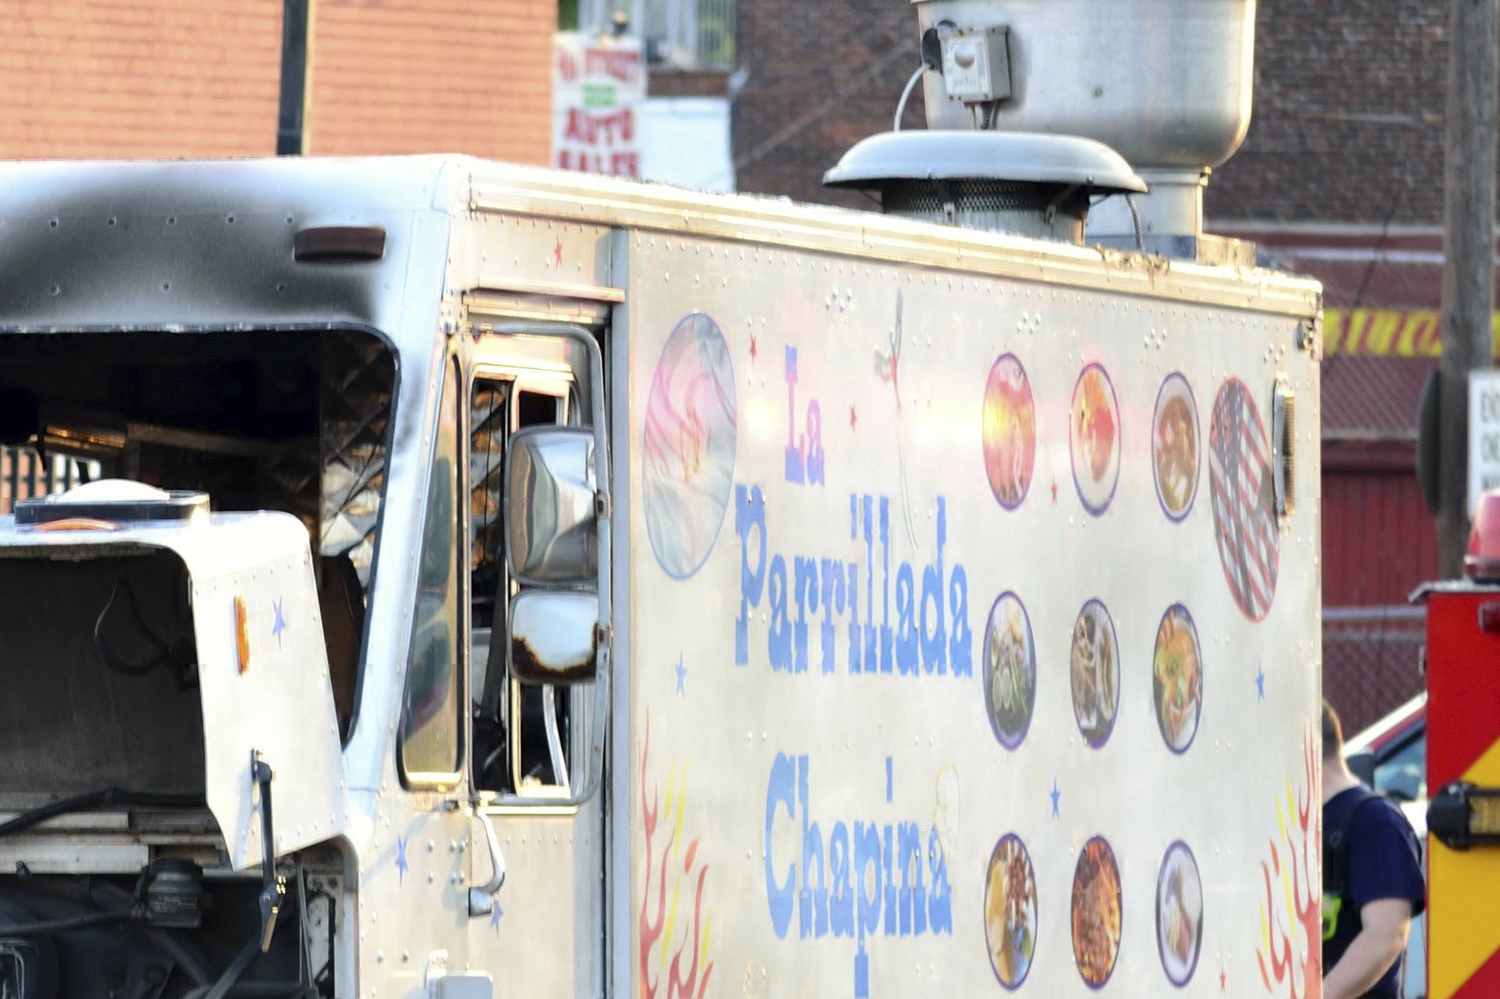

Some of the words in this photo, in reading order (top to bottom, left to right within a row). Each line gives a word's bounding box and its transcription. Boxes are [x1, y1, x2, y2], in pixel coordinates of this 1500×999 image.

[785, 344, 825, 487] La
[735, 483, 973, 679] Parrillada
[765, 750, 953, 999] Chapina
